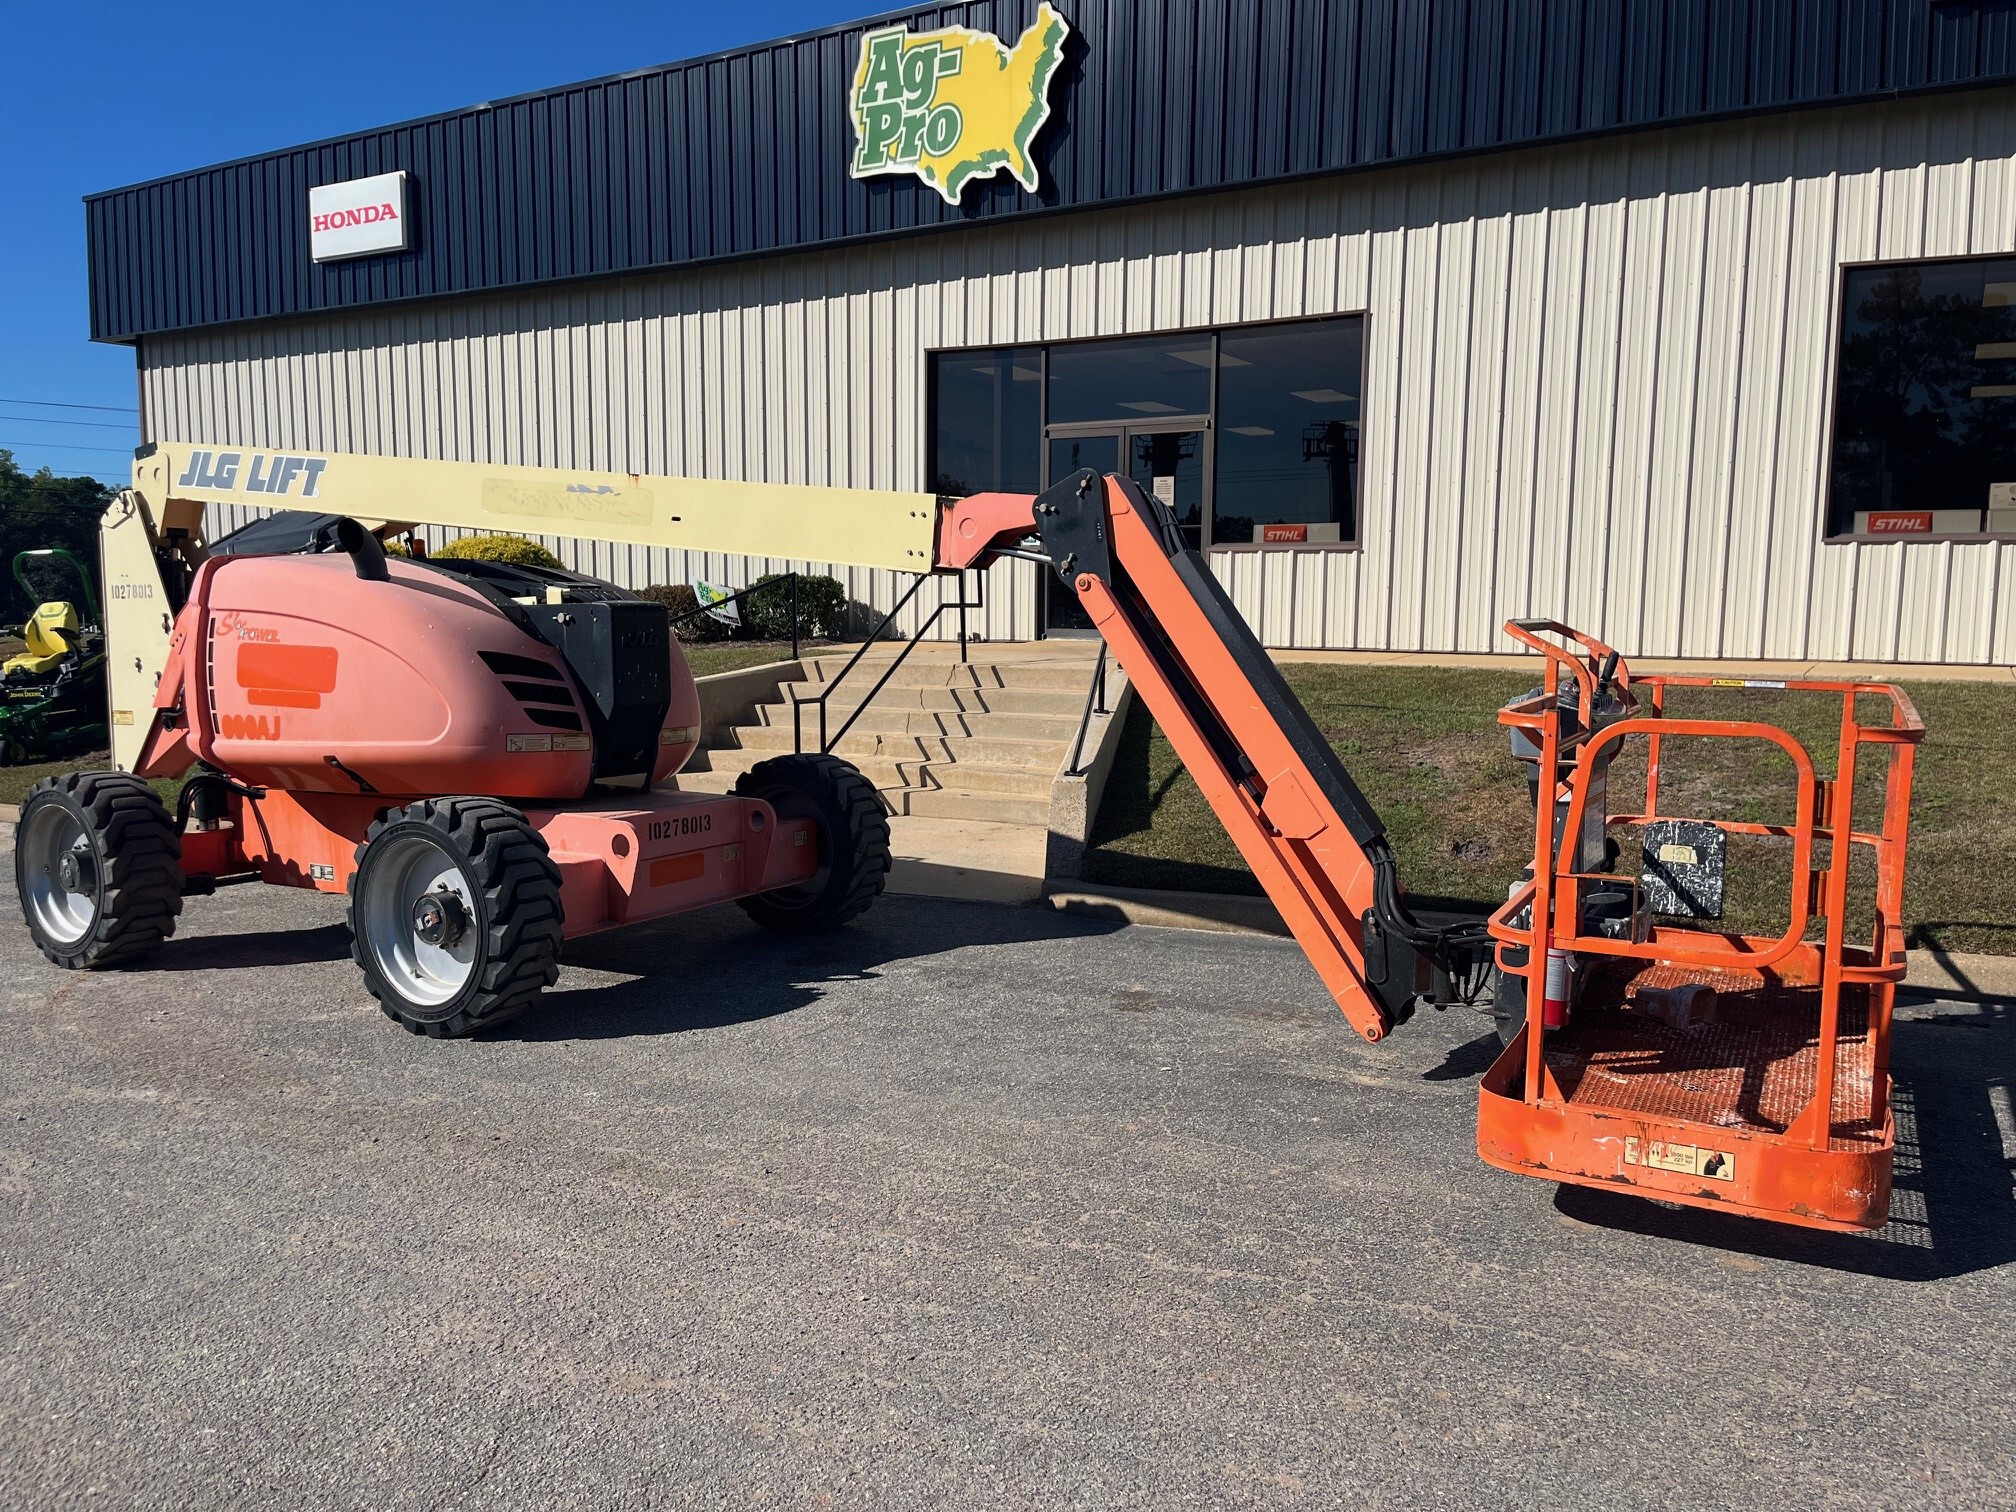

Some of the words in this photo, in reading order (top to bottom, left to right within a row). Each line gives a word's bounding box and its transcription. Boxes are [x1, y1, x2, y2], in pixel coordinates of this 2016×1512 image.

[858, 30, 963, 111] Ag-
[856, 100, 963, 171] Pro
[313, 203, 398, 232] HONDA
[178, 450, 242, 491] JLG
[245, 454, 328, 497] LIFT
[1265, 531, 1301, 541] STIHL
[1871, 518, 1925, 530] STIHL
[111, 584, 153, 599] 10278013
[648, 813, 711, 841] 10278013
